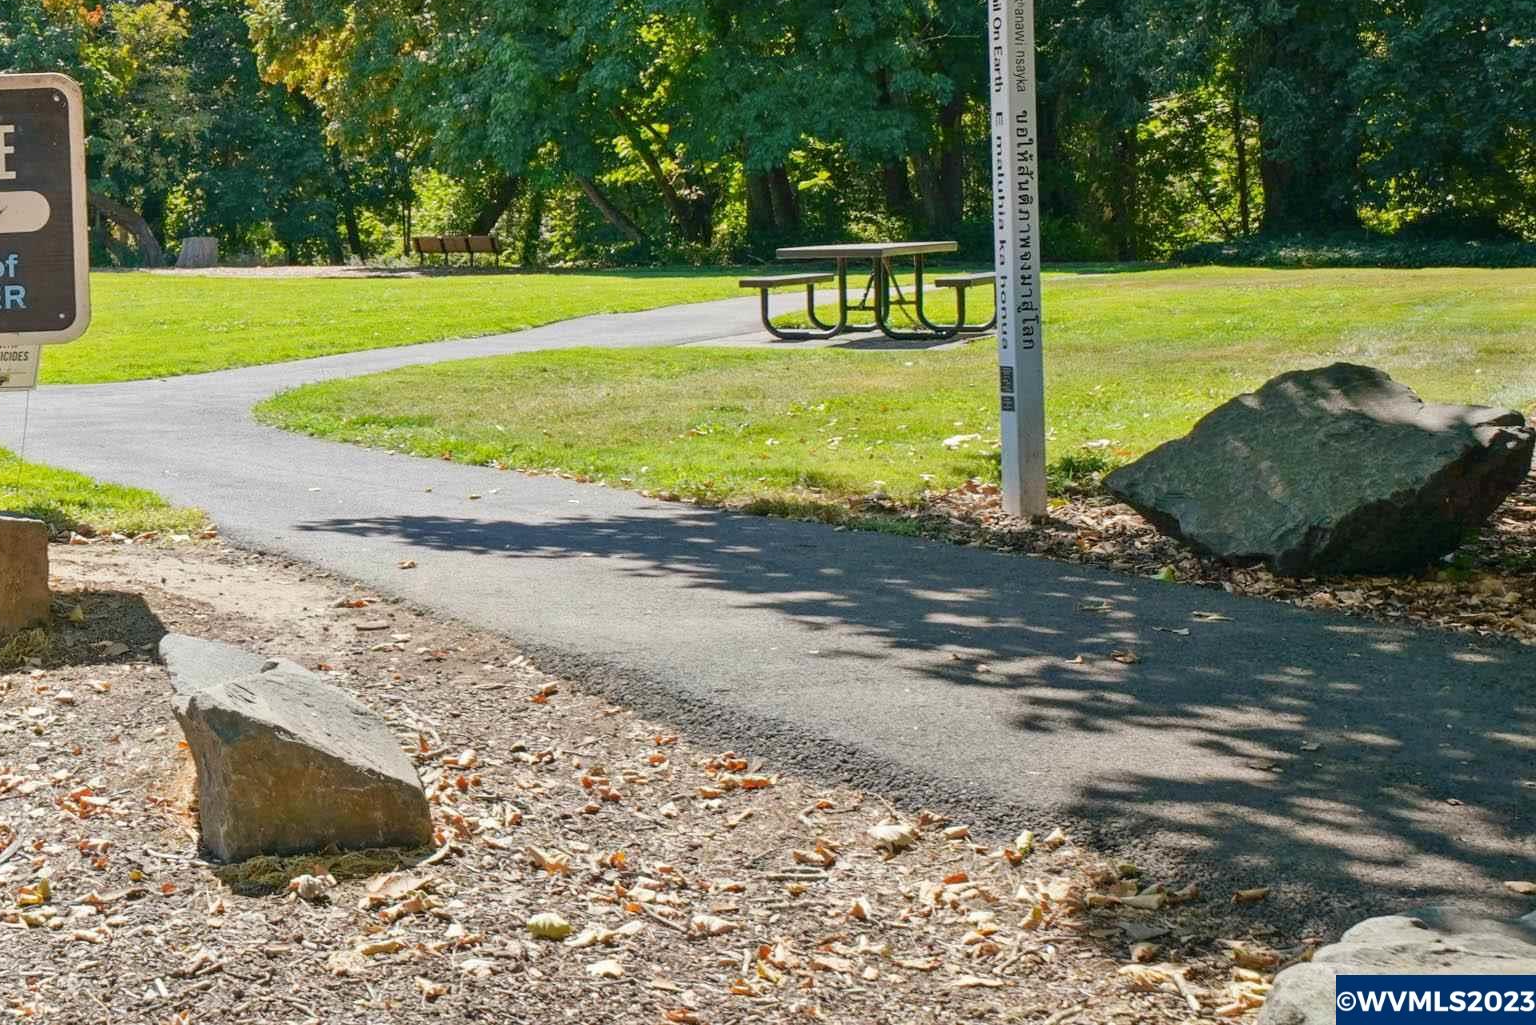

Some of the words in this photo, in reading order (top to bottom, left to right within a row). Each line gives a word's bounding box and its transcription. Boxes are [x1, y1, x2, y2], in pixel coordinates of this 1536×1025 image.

[993, 17, 1002, 41] On
[994, 46, 1004, 93] Earth
[999, 239, 1007, 266] ka
[1000, 275, 1009, 350] honua
